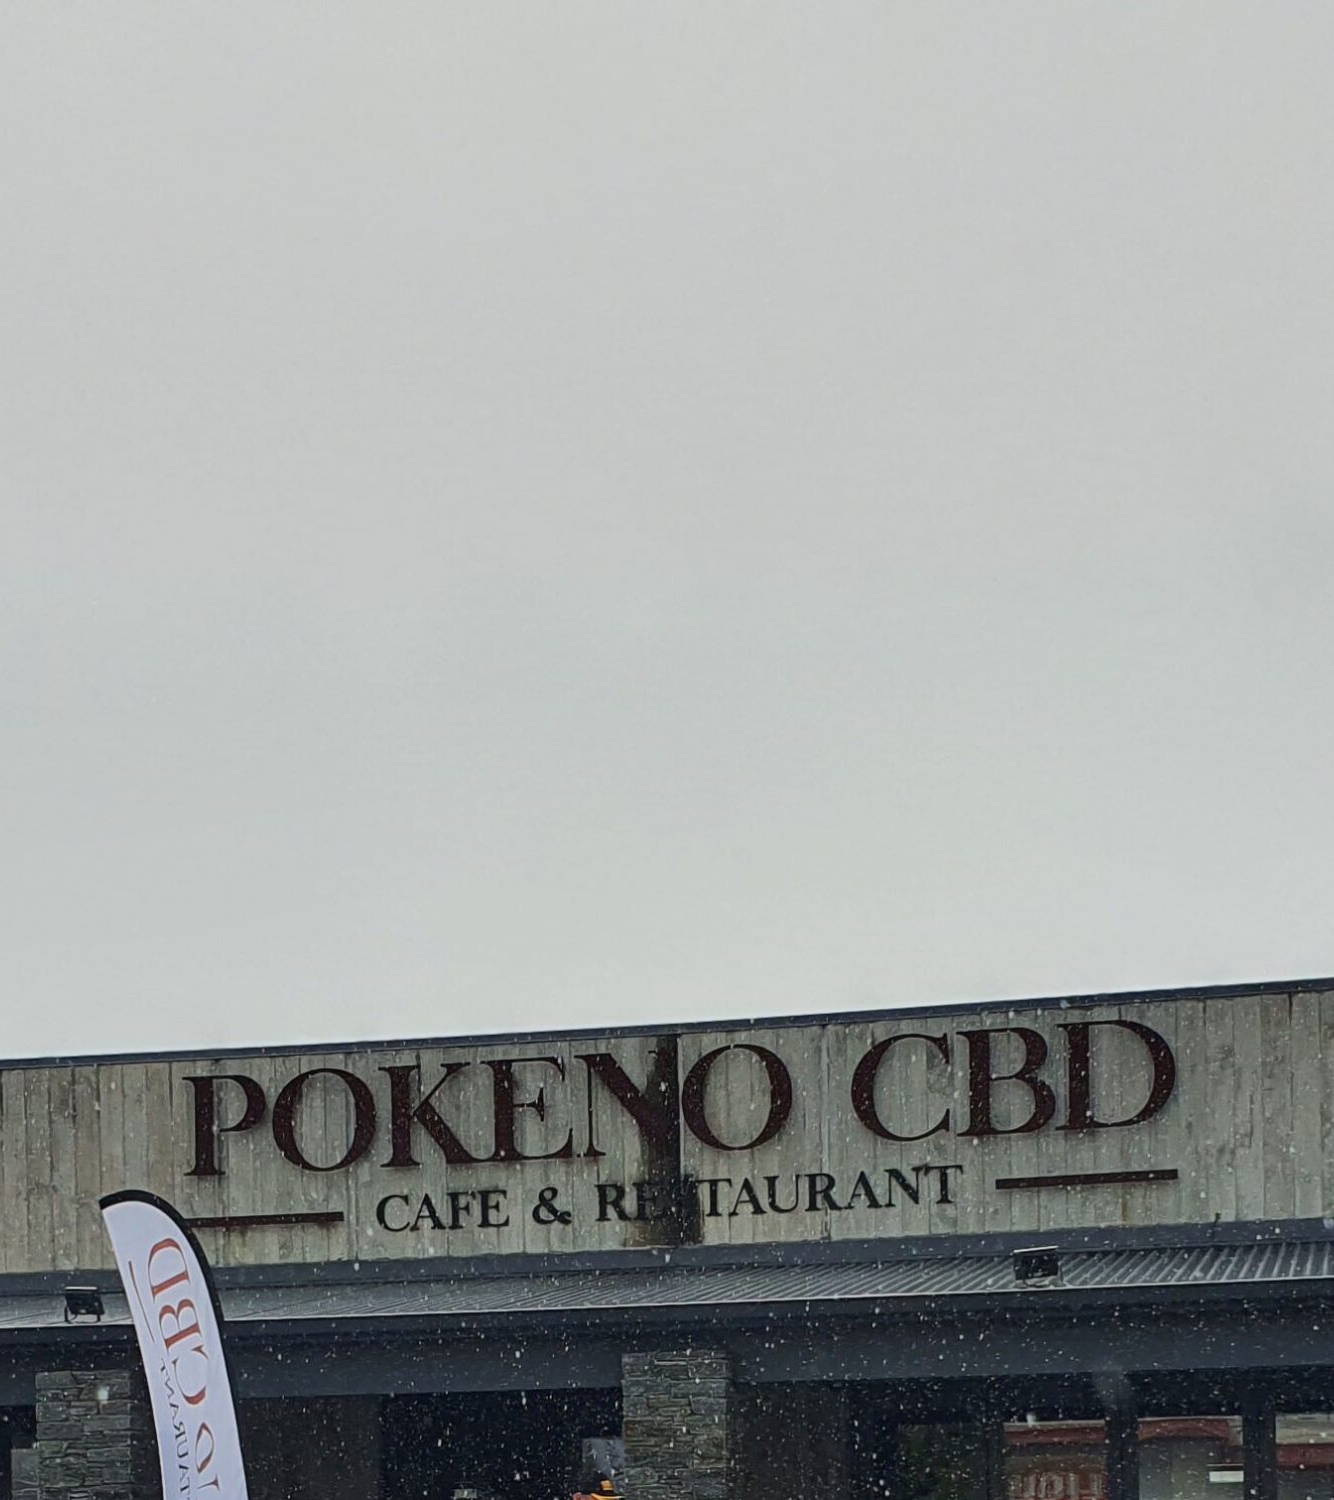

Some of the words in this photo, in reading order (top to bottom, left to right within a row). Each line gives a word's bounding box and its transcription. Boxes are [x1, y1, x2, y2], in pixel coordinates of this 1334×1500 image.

[182, 1044, 793, 1177] POKENO
[851, 1019, 1176, 1142] CBD
[376, 1189, 510, 1232] CAFE
[532, 1186, 573, 1225] &
[594, 1163, 964, 1223] RETAURANT
